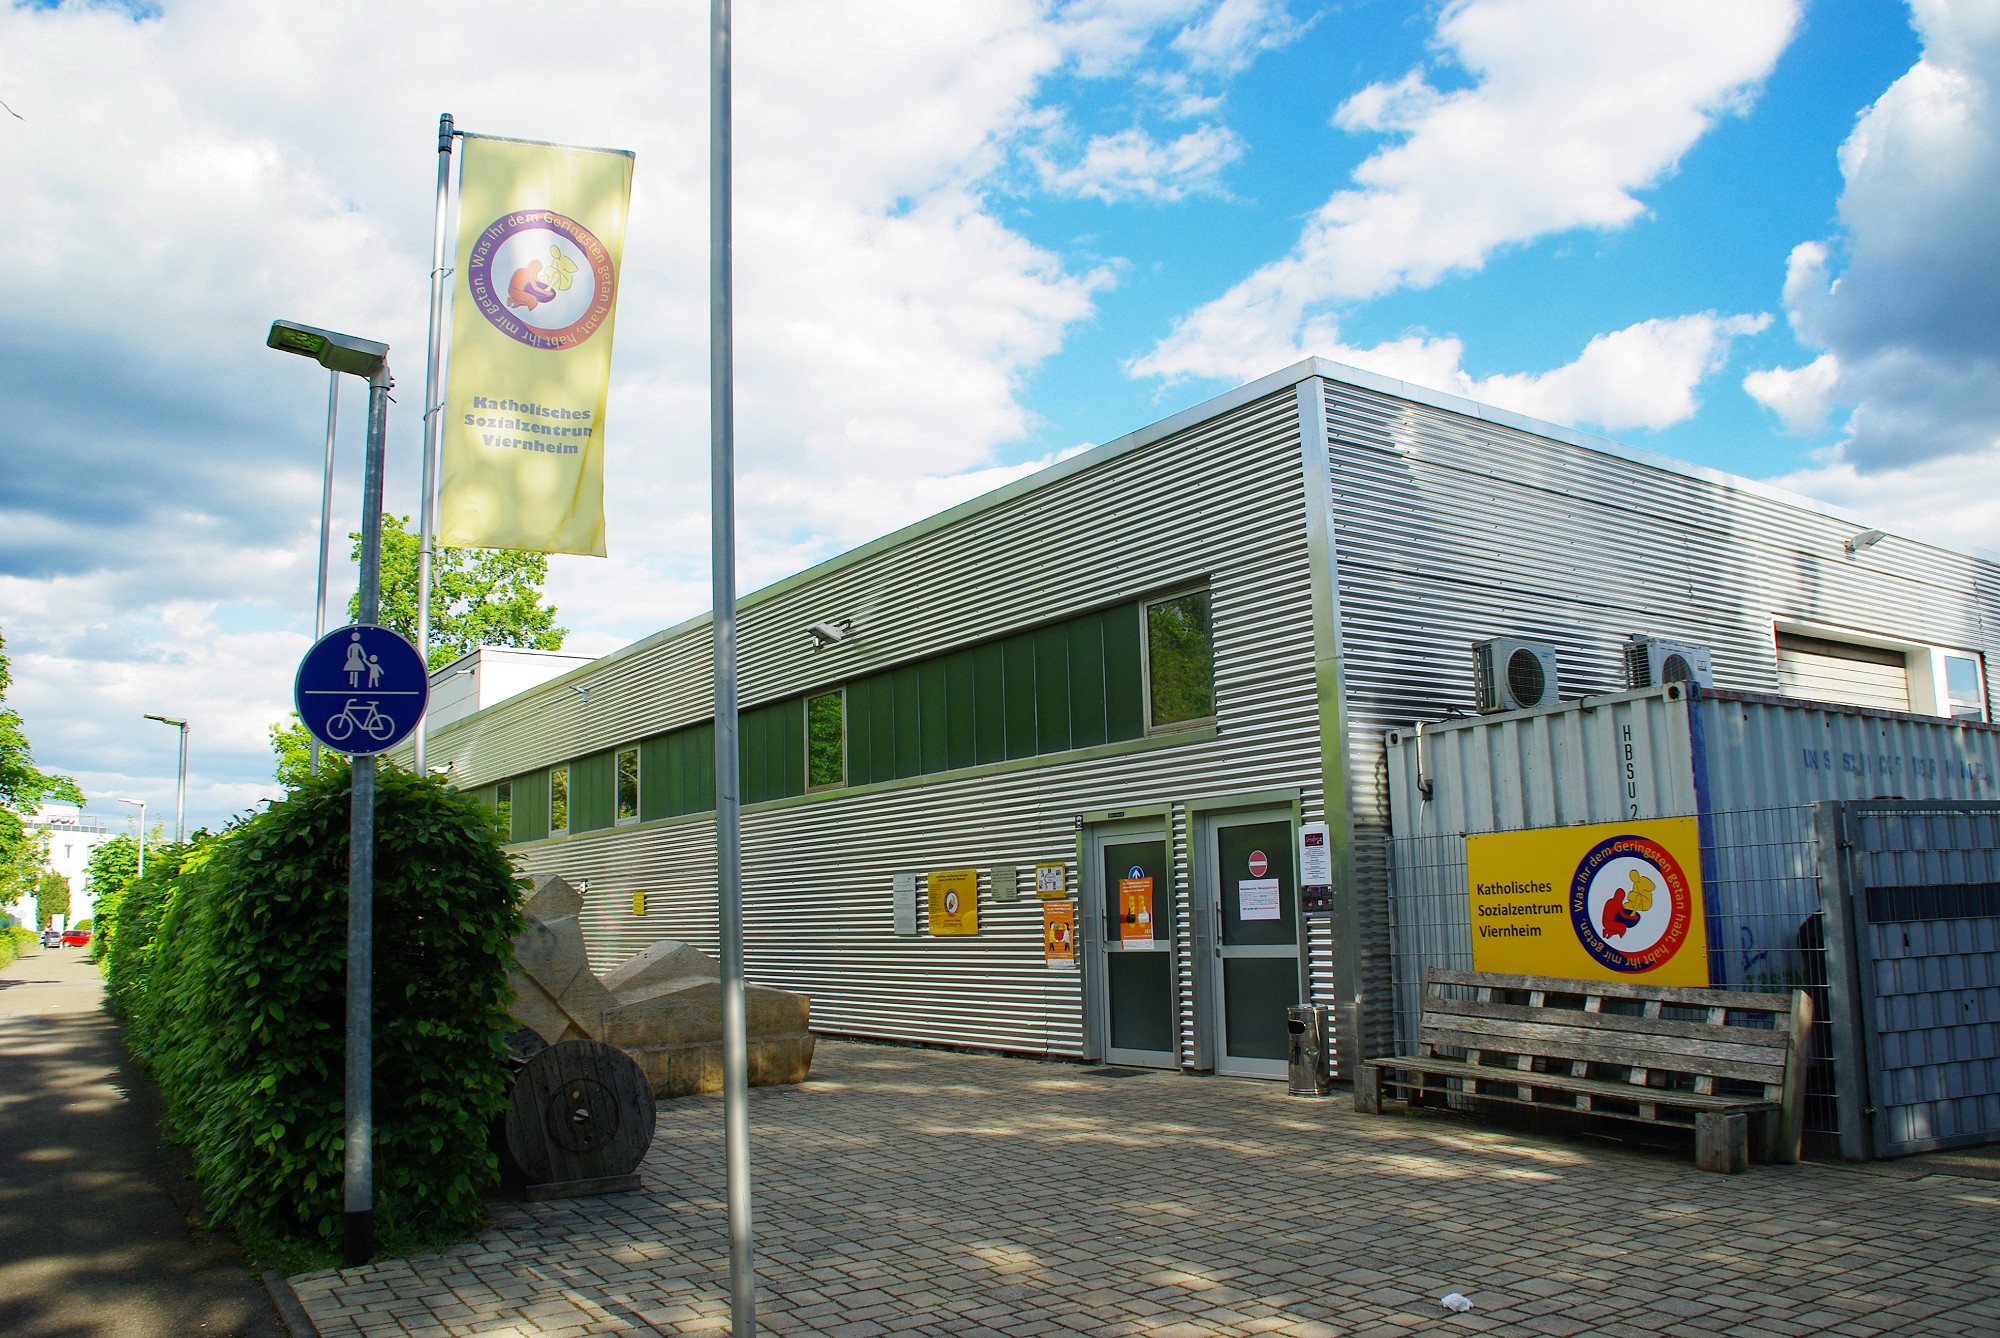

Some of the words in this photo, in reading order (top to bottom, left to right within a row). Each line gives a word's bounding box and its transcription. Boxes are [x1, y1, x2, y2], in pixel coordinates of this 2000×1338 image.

[508, 213, 539, 227] dem
[487, 223, 505, 240] ihr
[543, 213, 605, 263] Geringsten
[471, 241, 491, 268] Was
[598, 265, 612, 302] getan
[495, 317, 519, 334] mir
[522, 331, 541, 347] ihr
[545, 333, 578, 349] habt
[473, 396, 591, 420] Katholisches
[482, 434, 579, 454] Viernheim
[1590, 847, 1611, 867] dem
[1613, 841, 1671, 873] Geringsten
[1577, 866, 1592, 884] ihr
[1477, 880, 1552, 896] Katholisches
[1667, 873, 1684, 910] getan
[1574, 886, 1585, 912] Was
[1478, 902, 1563, 917] Sozialzentrum
[1479, 923, 1542, 938] Viernheim
[1603, 951, 1623, 964] mir
[1643, 944, 1669, 963] habt
[1625, 957, 1641, 970] ihr
